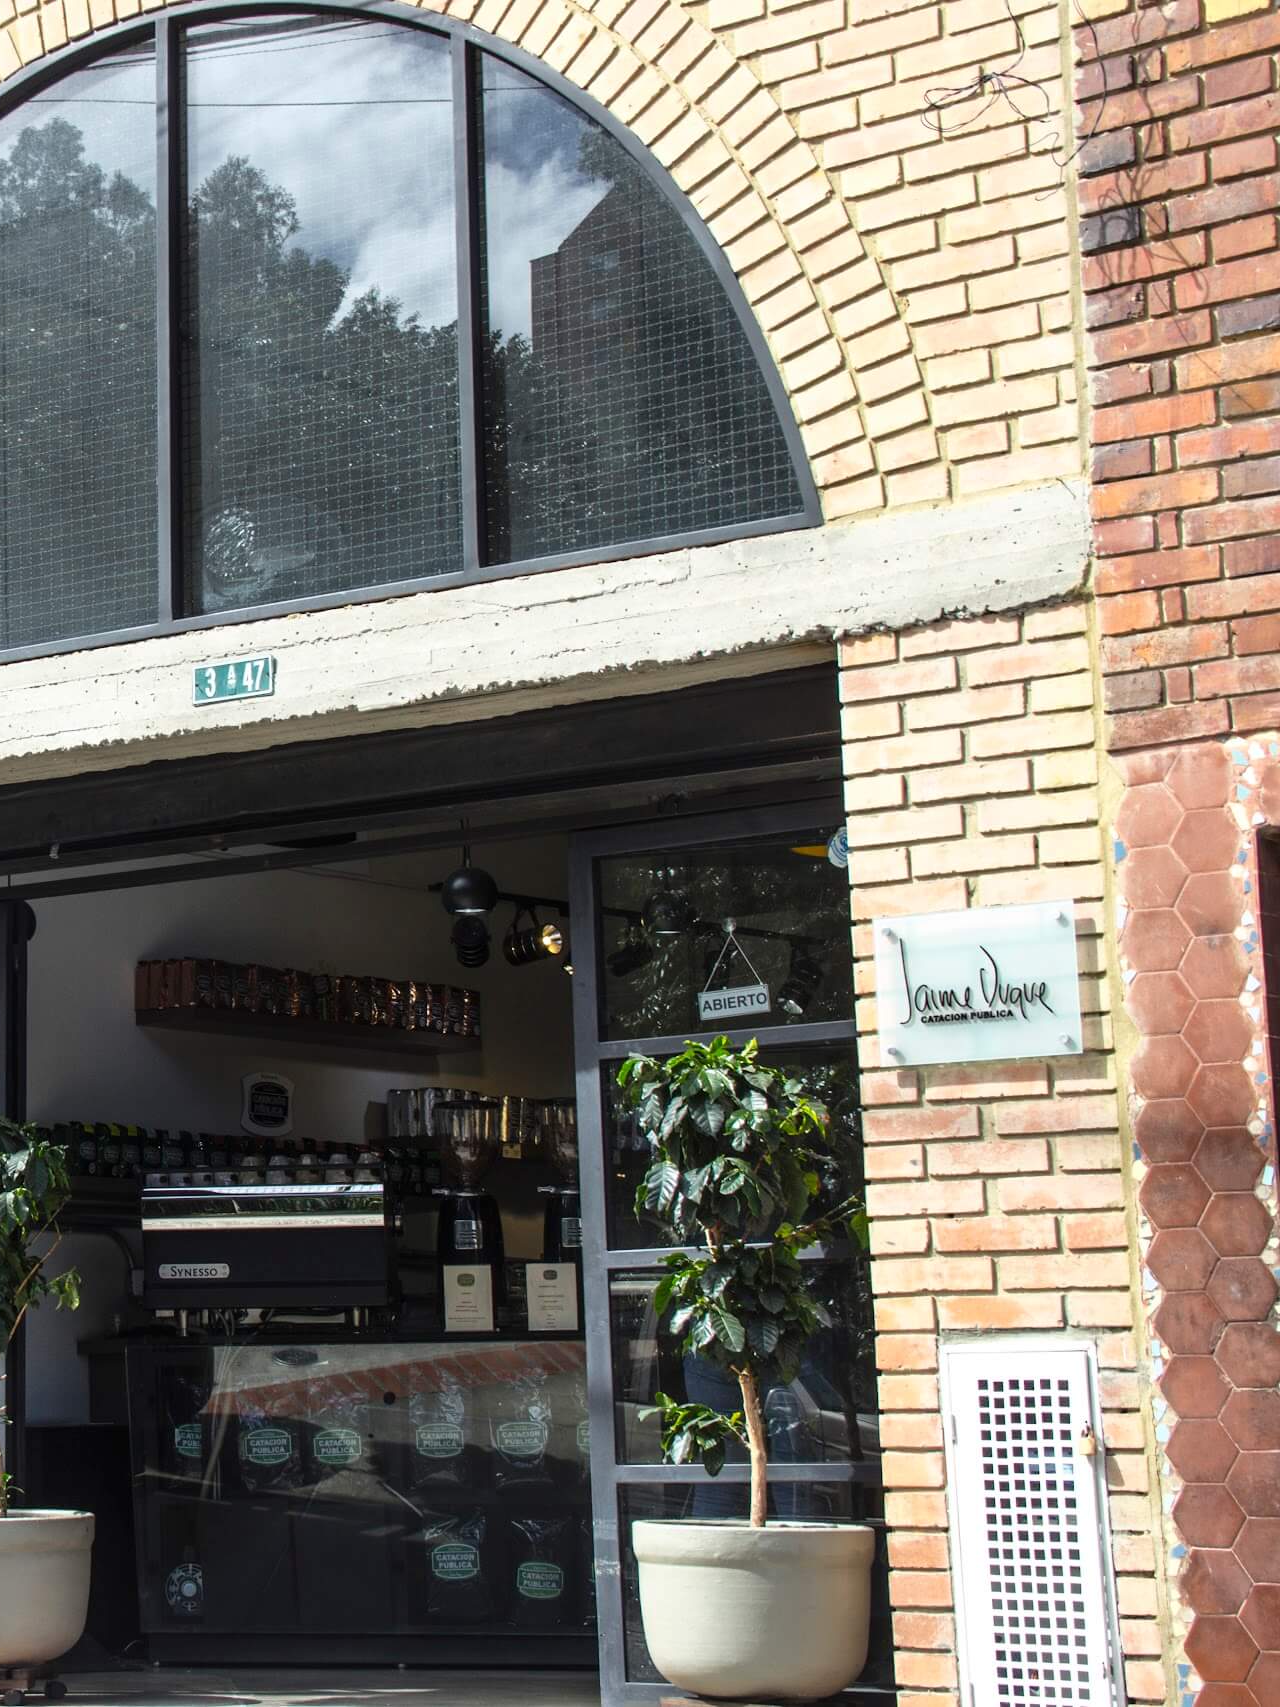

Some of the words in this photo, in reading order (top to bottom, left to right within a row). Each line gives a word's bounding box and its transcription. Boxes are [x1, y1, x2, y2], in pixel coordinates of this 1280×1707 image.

[204, 667, 217, 698] 3
[242, 660, 265, 692] 47
[899, 937, 973, 1025] Jaime
[978, 944, 1057, 1021] Duque
[702, 991, 768, 1013] ABIERTO
[170, 1265, 218, 1277] SYNESSO
